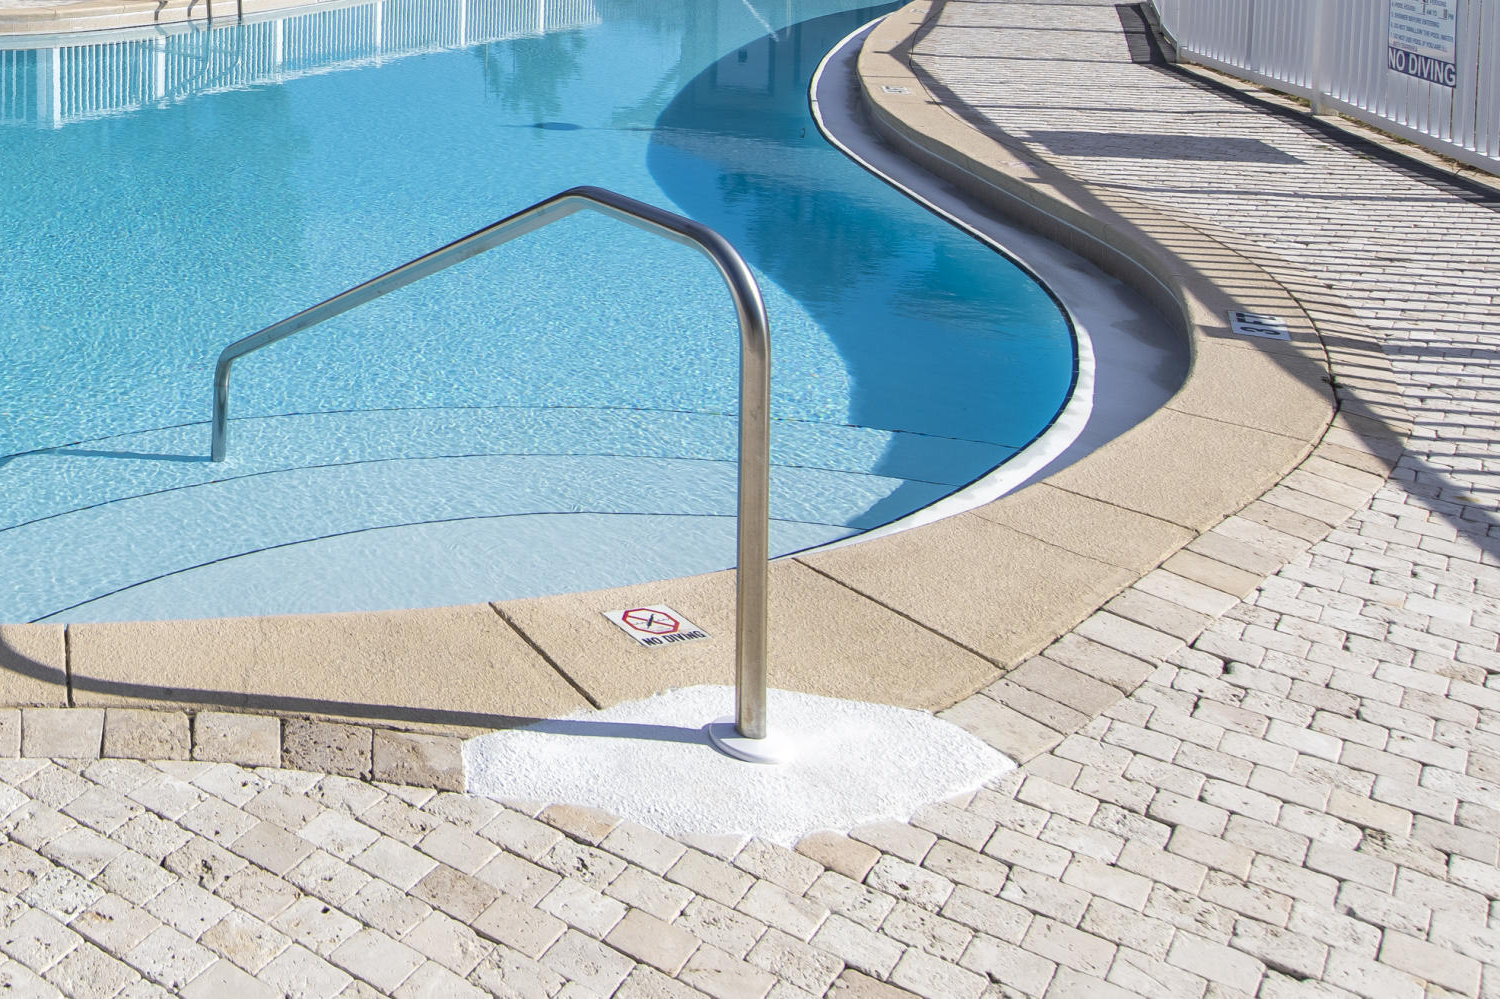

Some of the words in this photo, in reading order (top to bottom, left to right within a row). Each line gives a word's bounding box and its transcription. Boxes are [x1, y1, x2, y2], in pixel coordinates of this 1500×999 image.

[1388, 47, 1406, 71] NO
[1408, 53, 1456, 86] DIVING
[1240, 326, 1281, 335] 3
[641, 636, 663, 646] NO
[661, 630, 707, 643] DIVING
